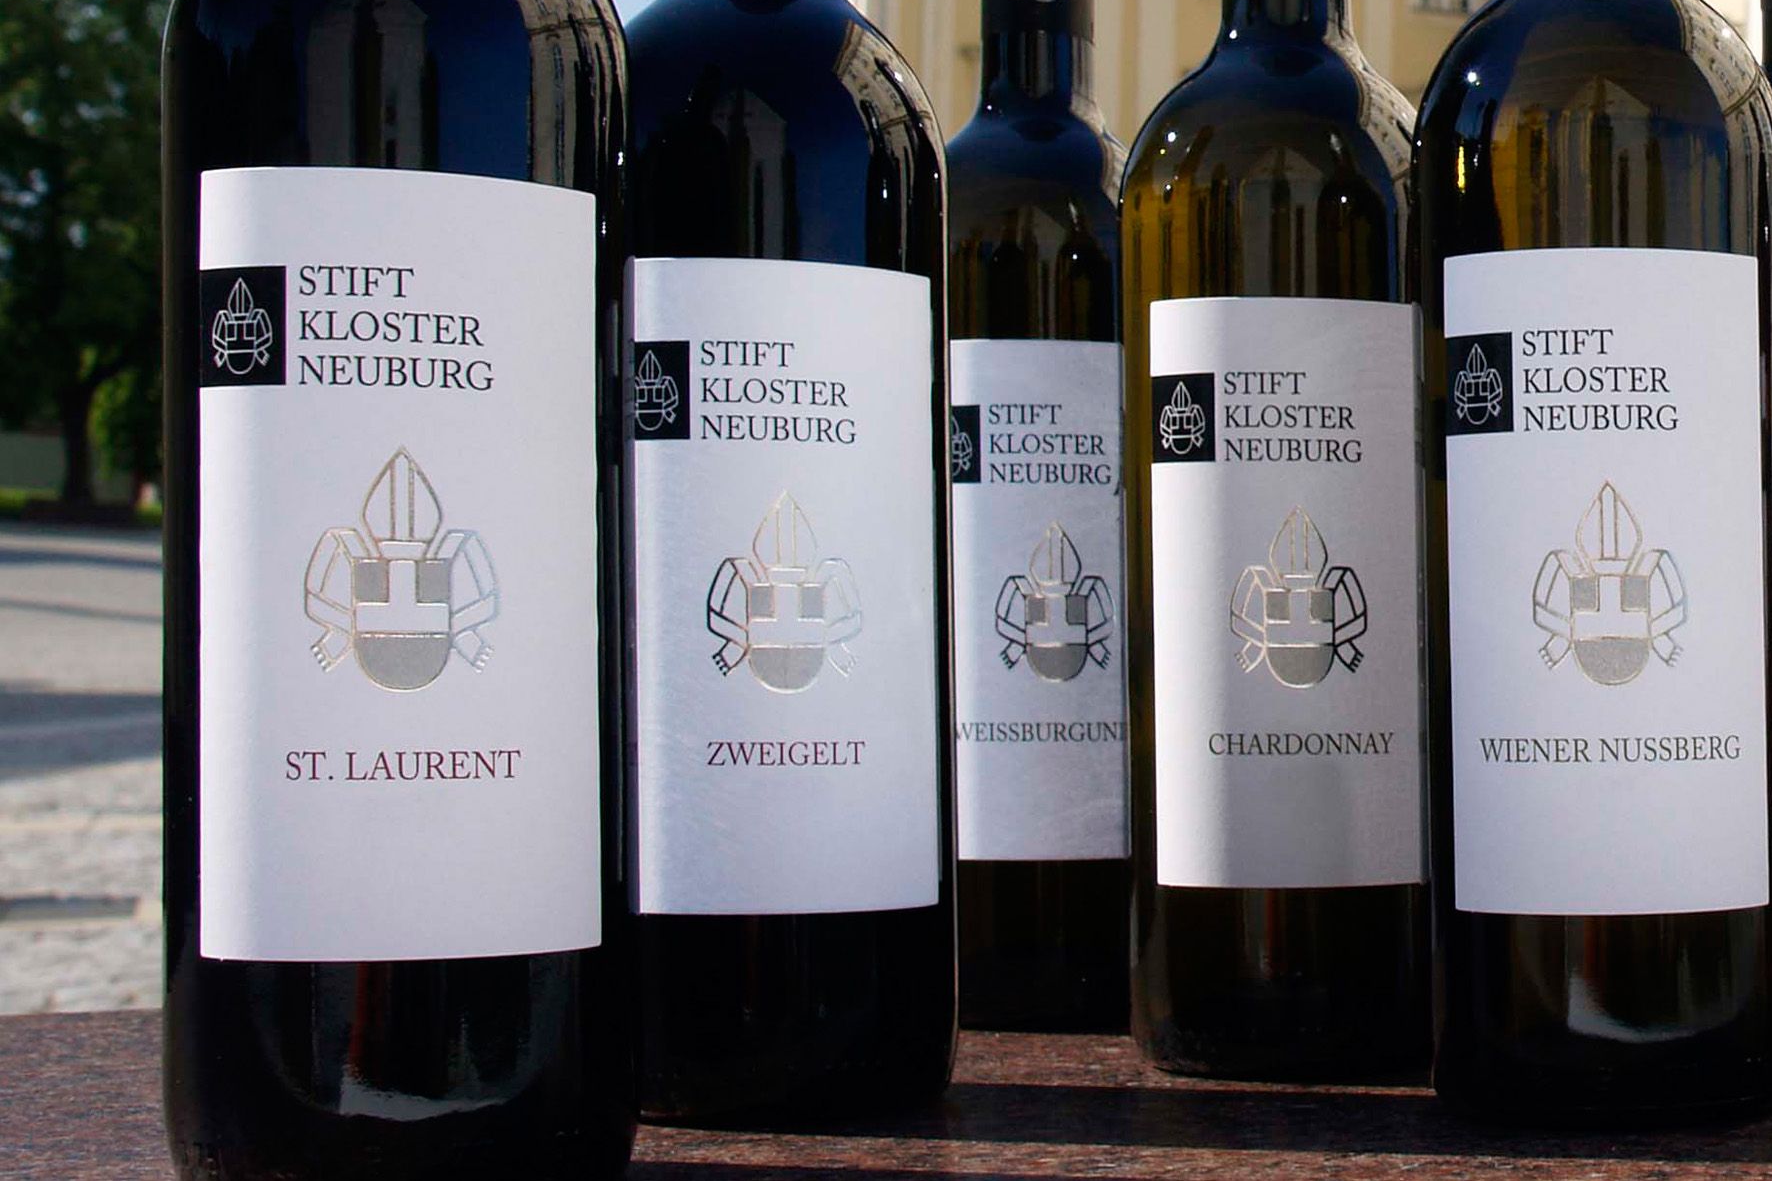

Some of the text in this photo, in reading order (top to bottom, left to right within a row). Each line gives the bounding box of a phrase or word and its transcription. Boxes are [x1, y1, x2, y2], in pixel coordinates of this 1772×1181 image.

[300, 266, 414, 297] STIFT
[300, 311, 484, 346] KLOSTER
[701, 341, 794, 367] STIFT
[1523, 329, 1613, 356] STIFT
[299, 355, 493, 391] NEUBURG
[1224, 372, 1306, 395] STIFT
[1524, 366, 1669, 393] KLOSTER
[701, 378, 847, 407] KLOSTER
[989, 404, 1062, 425] STIFT
[1225, 405, 1355, 429] KLOSTER
[1524, 405, 1678, 431] NEUBURG
[701, 415, 855, 444] NEUBURG
[990, 434, 1105, 455] KLOSTER
[1225, 439, 1362, 463] NEUBURG
[990, 463, 1111, 484] NEUBURG
[707, 741, 865, 766] ZWEIGELT
[1209, 732, 1394, 756] CHARDONNAY
[1480, 735, 1740, 763] WIENER NUSSBERG
[286, 750, 521, 780] ST. LAURENT
